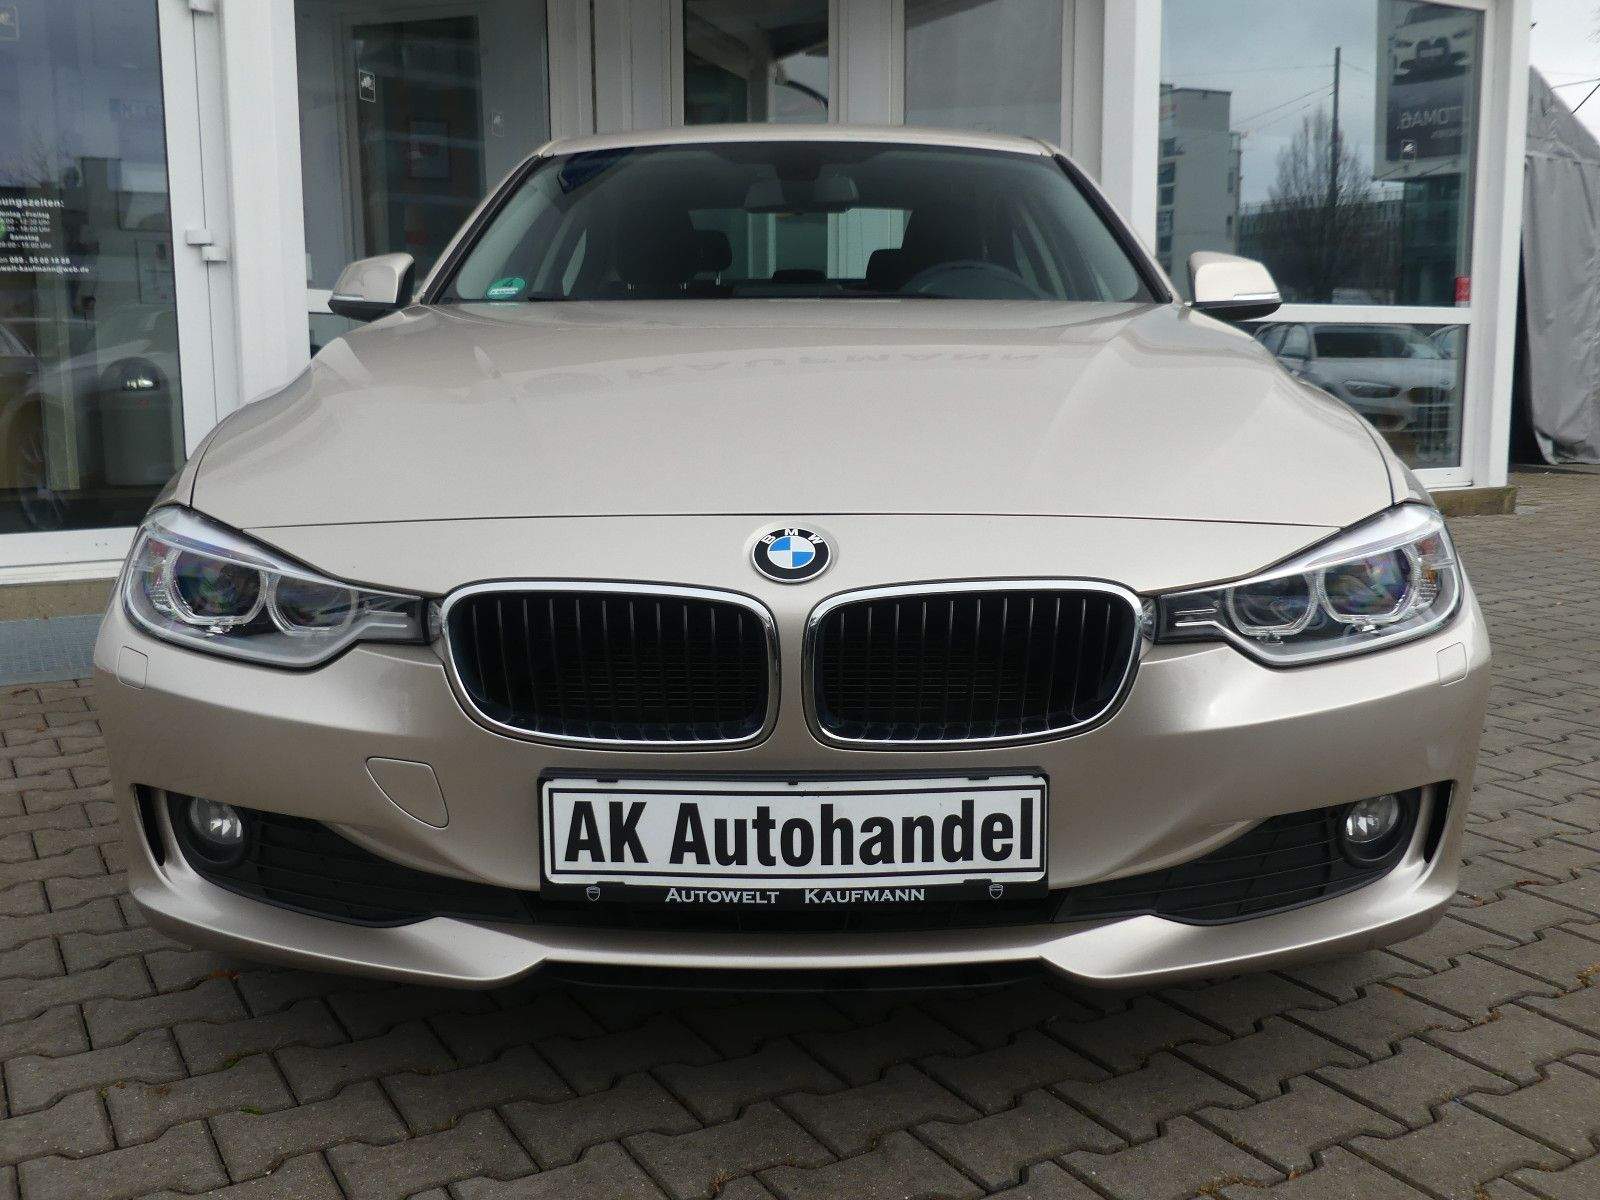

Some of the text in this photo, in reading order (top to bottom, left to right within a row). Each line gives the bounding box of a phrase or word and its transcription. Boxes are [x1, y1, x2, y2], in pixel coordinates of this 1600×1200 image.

[760, 528, 825, 545] BMW
[564, 797, 1034, 867] AK Autohandel
[664, 887, 926, 905] AUTOWELT KAUFMANN
